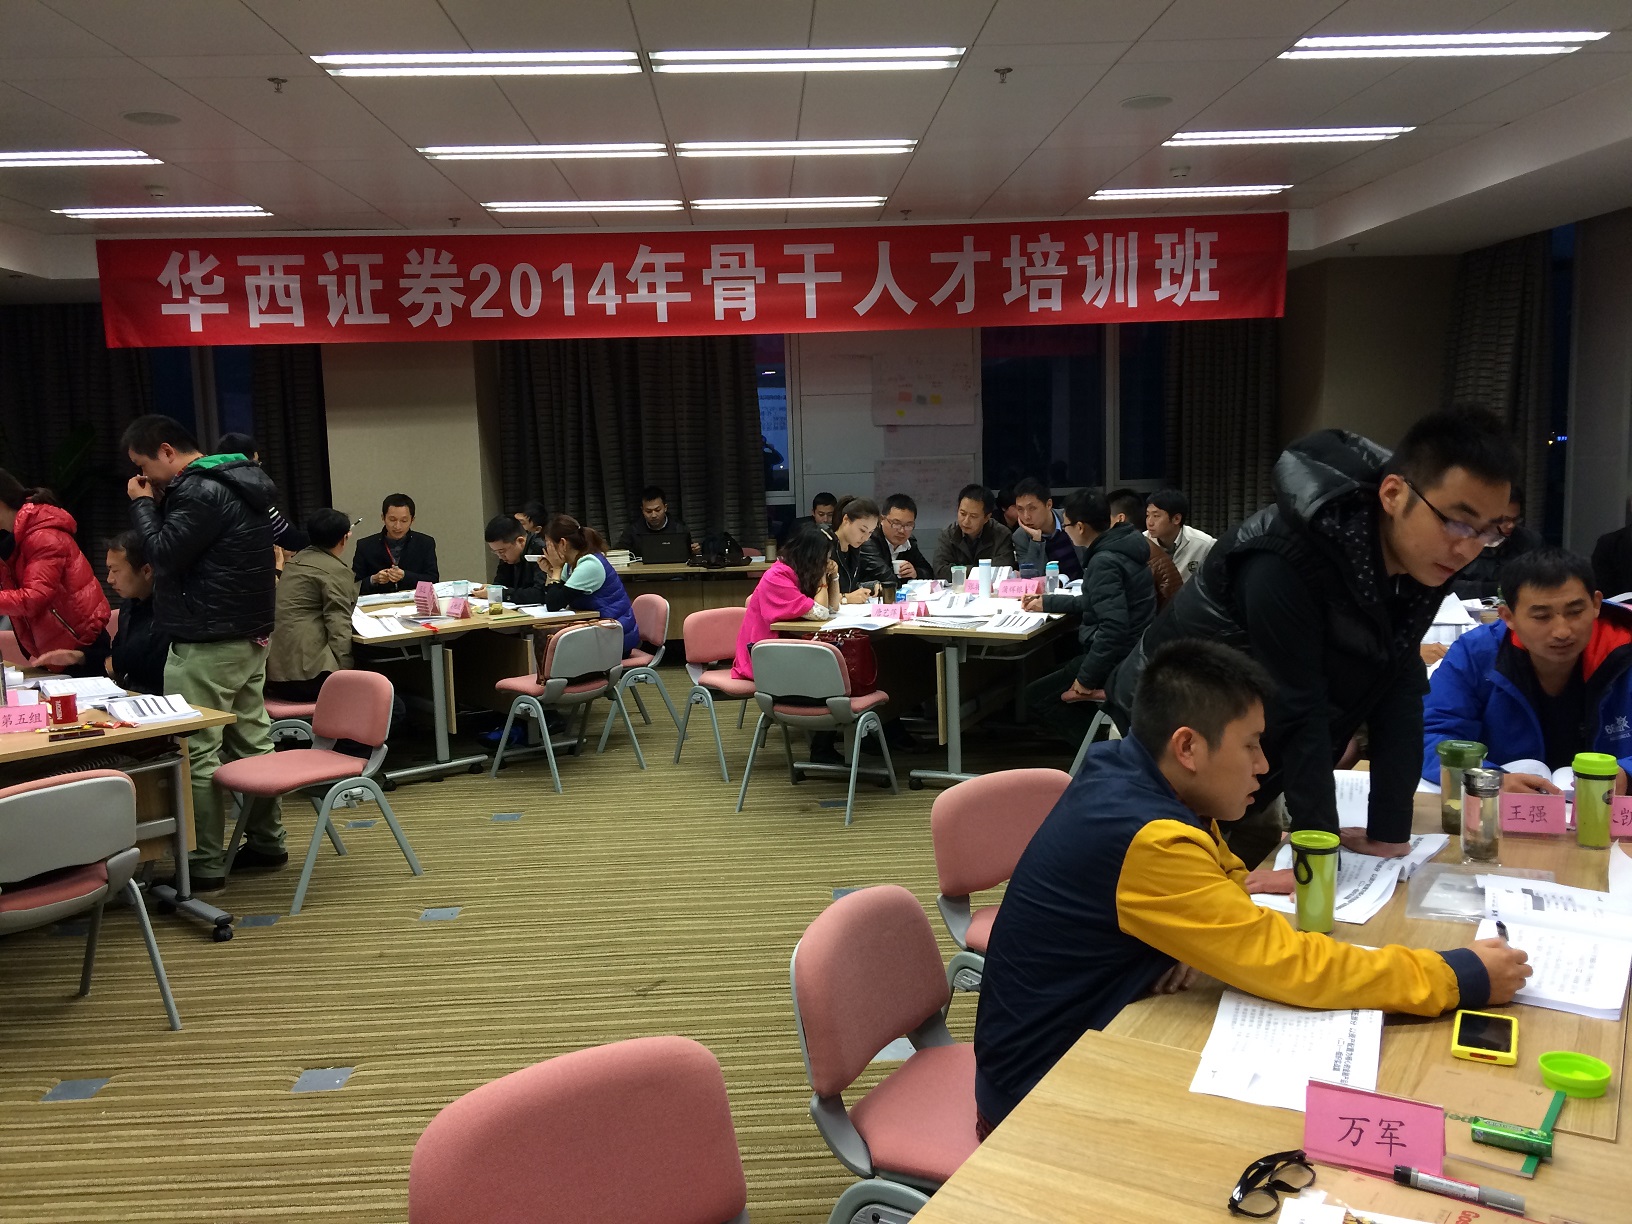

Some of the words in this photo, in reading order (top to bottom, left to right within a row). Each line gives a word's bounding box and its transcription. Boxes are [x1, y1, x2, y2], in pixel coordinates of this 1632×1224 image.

[157, 227, 1220, 332] 华西证券2014年骨干人才培训班
[2, 712, 43, 728] 第五组
[1507, 805, 1548, 823] 王强
[1613, 808, 1632, 826] 凯
[1337, 1116, 1407, 1157] 万军
